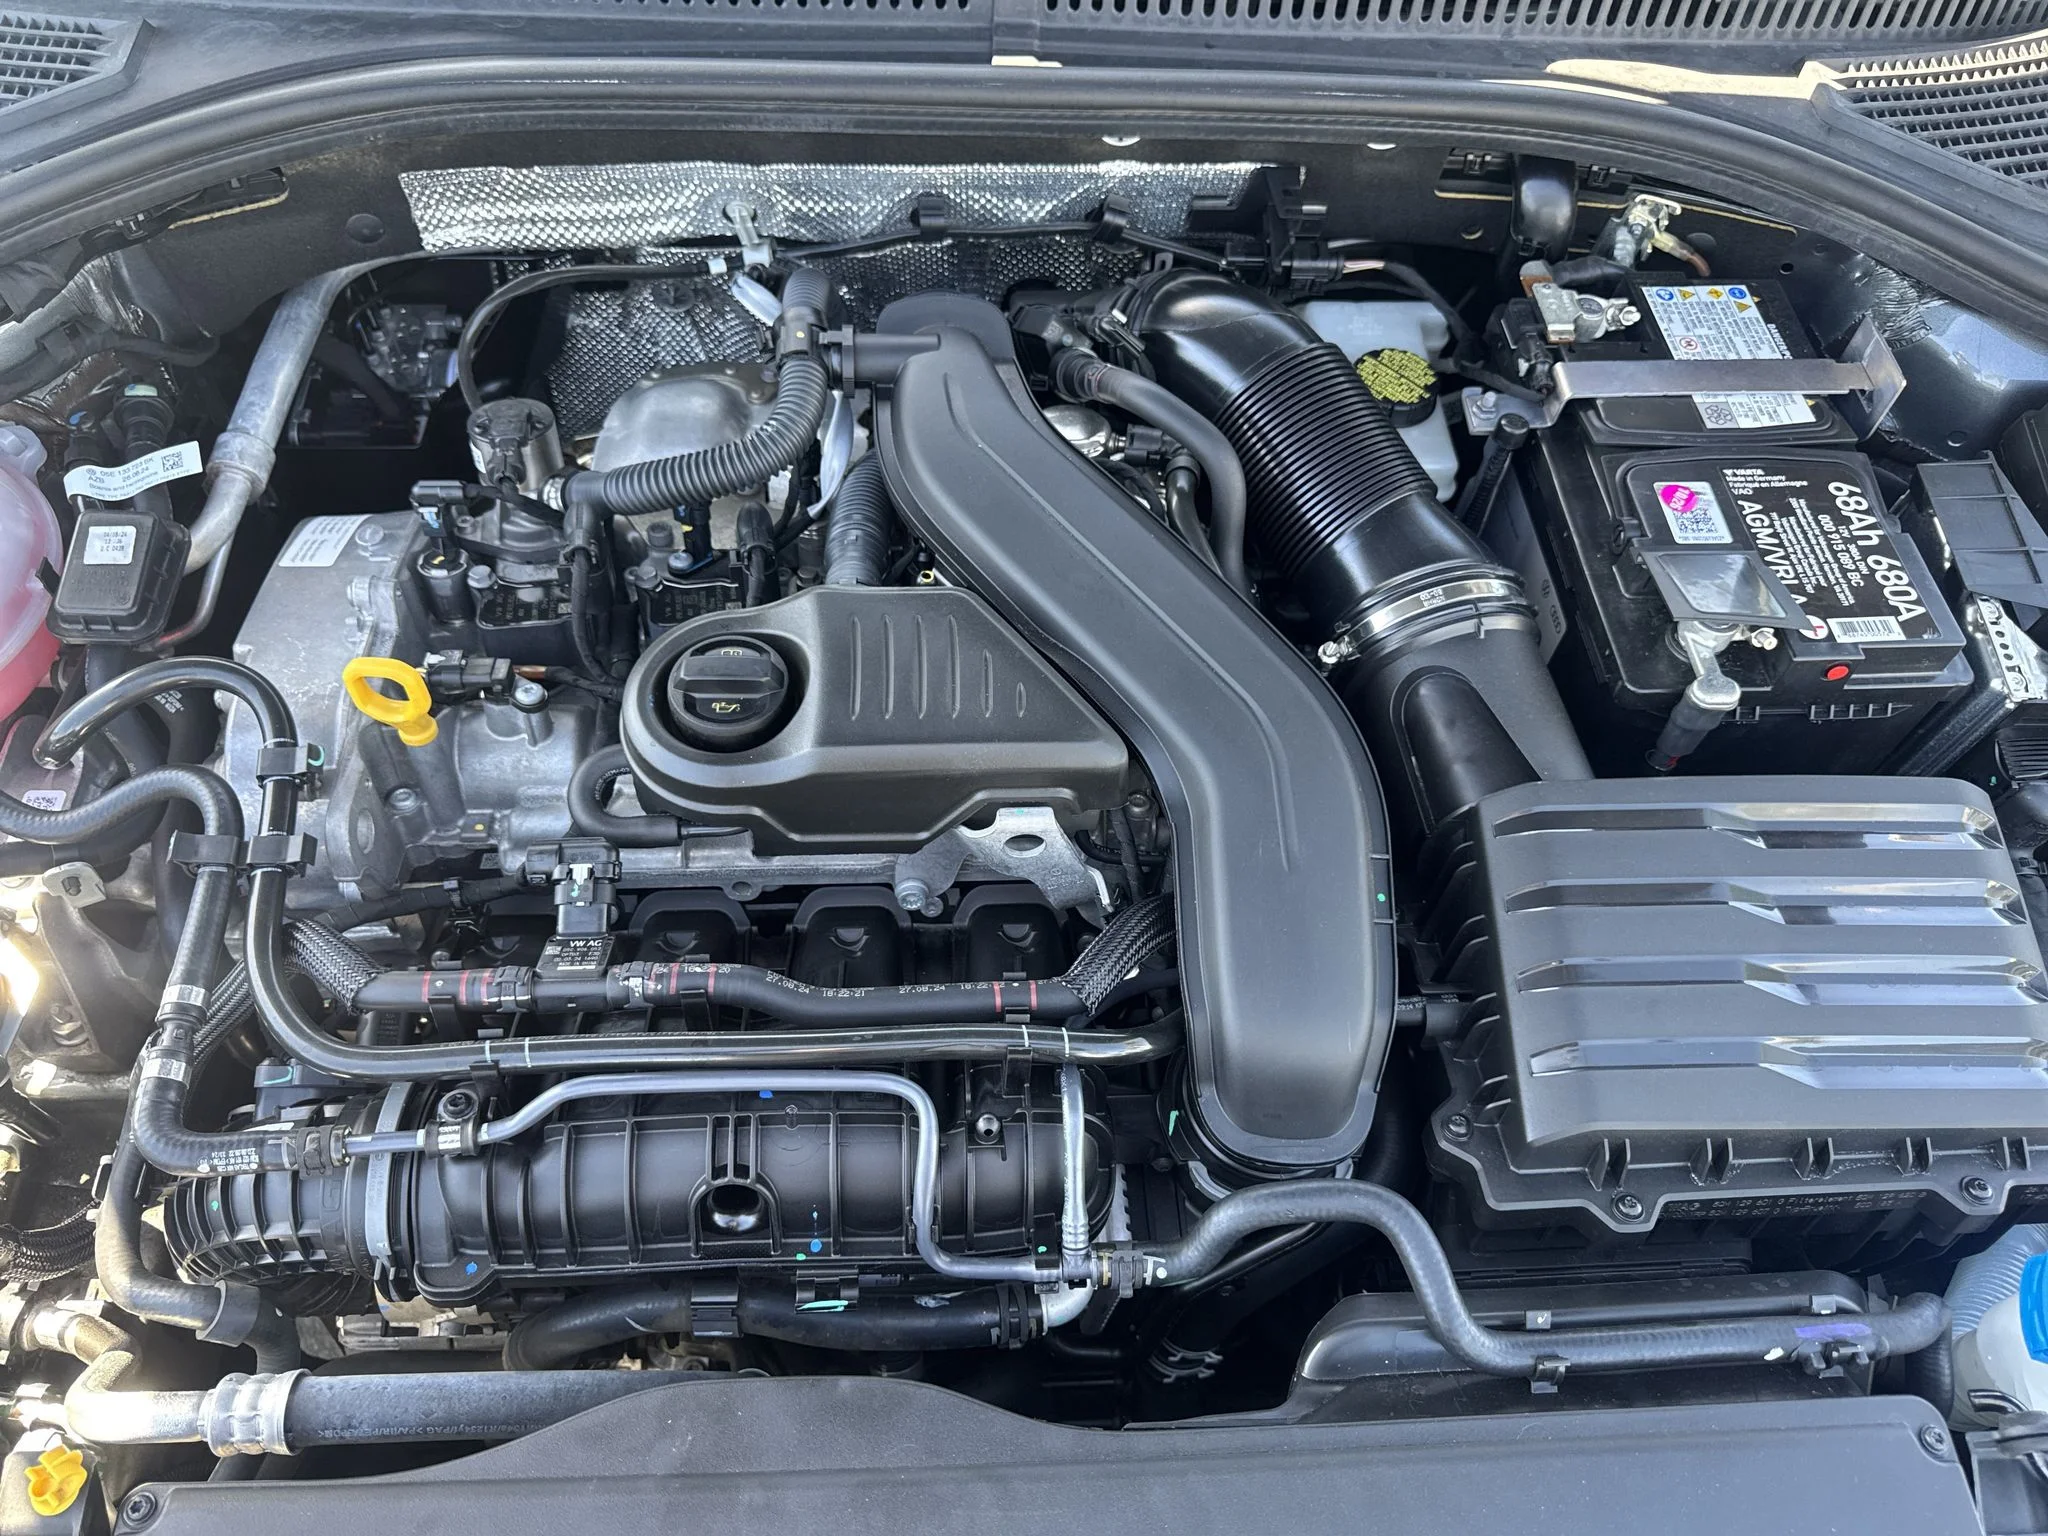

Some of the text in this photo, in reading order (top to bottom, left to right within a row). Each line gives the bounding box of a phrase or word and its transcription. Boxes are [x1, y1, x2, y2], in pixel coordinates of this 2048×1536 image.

[1816, 514, 1865, 586] 000 915 089 BC
[1828, 482, 1884, 546] 68Ah
[1866, 554, 1926, 622] 680A
[1836, 525, 1850, 537] 12V
[1855, 561, 1869, 574] DIN
